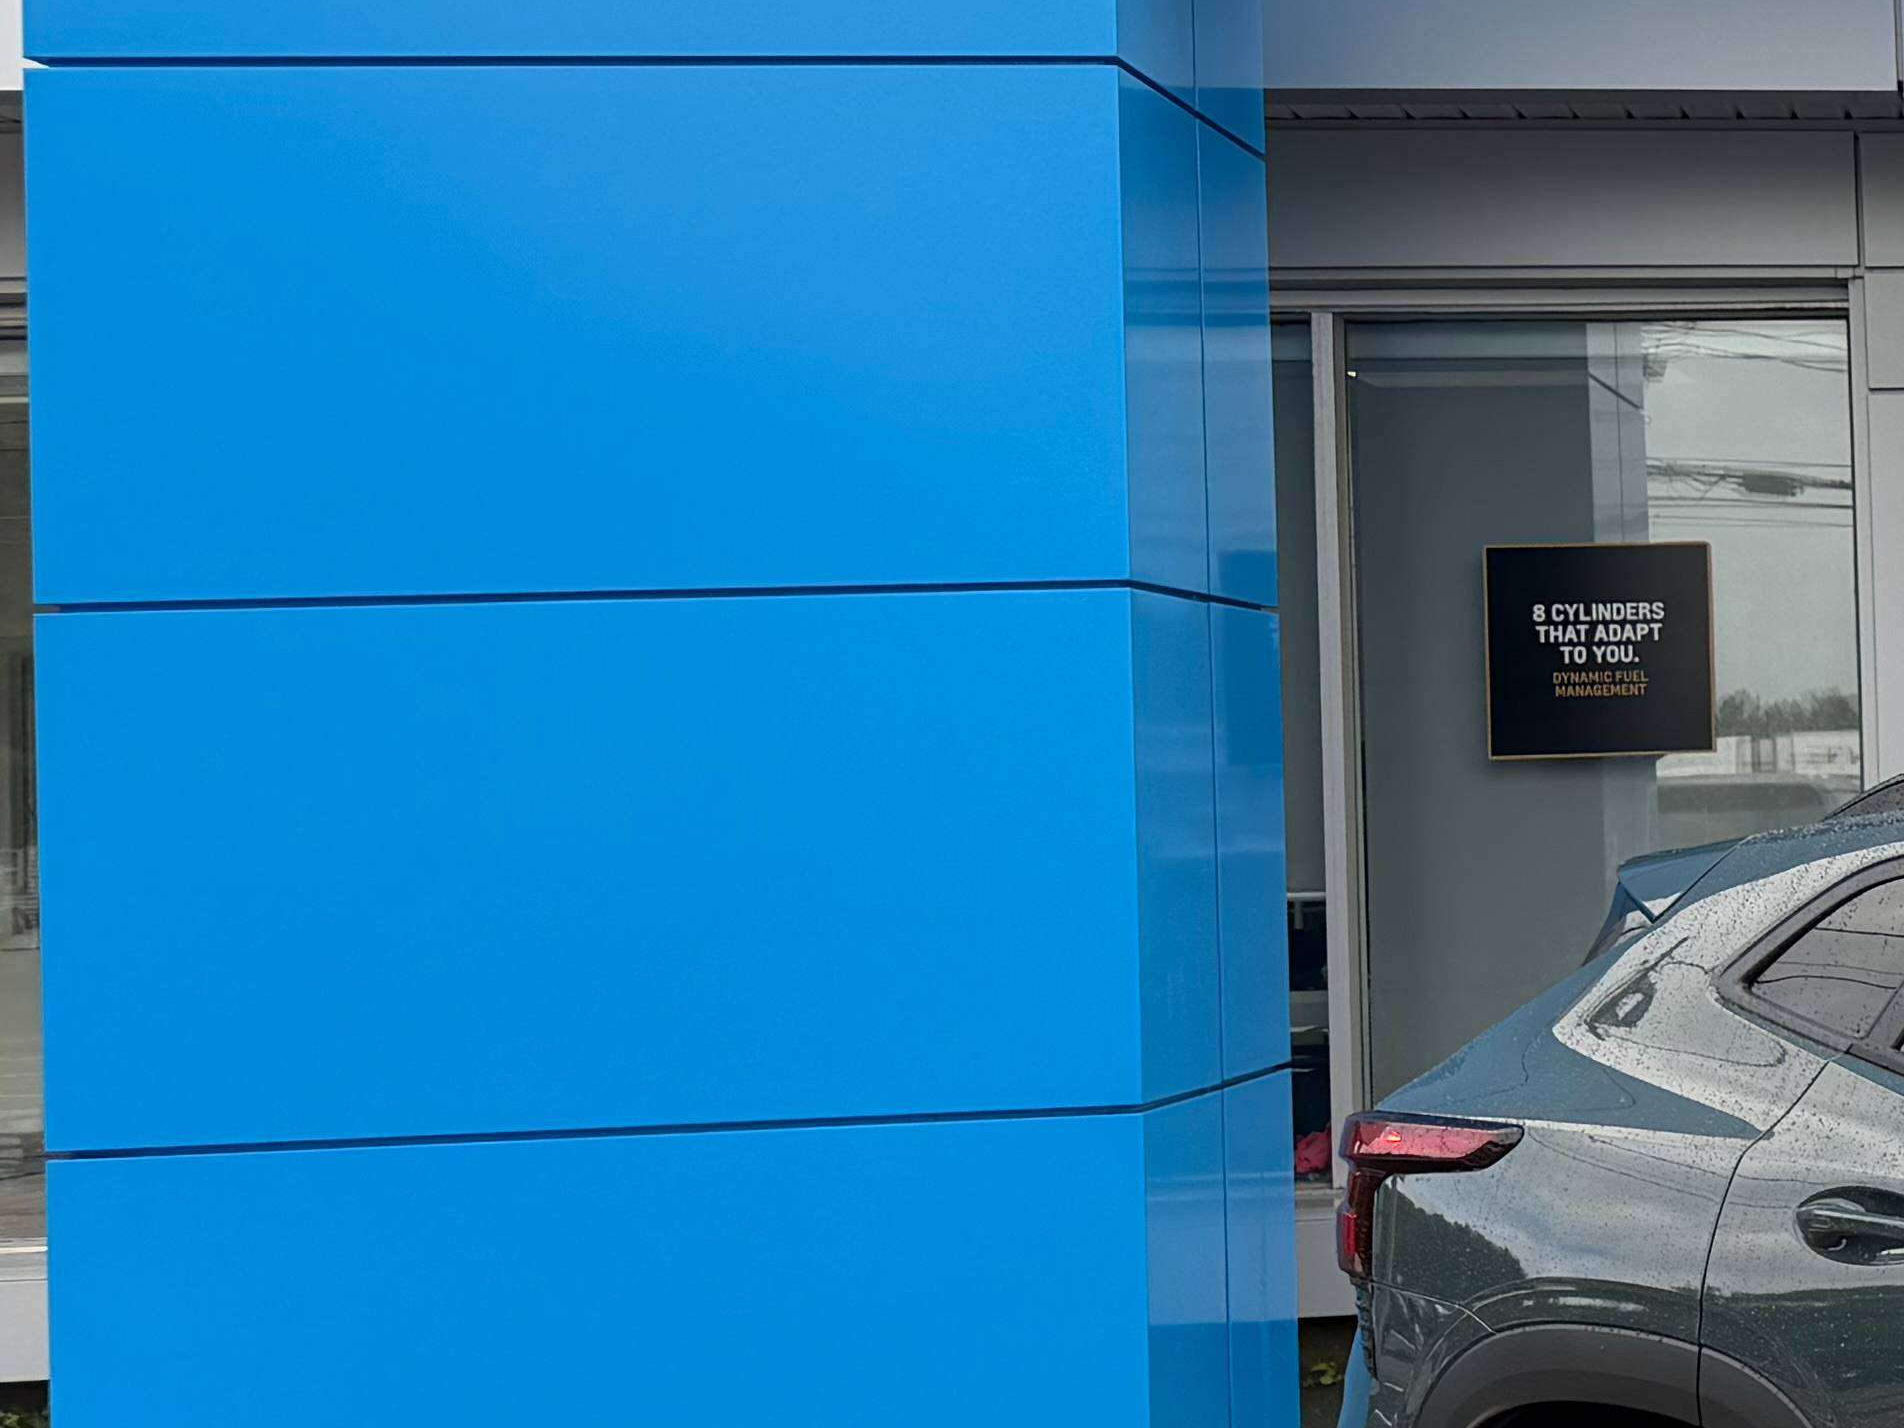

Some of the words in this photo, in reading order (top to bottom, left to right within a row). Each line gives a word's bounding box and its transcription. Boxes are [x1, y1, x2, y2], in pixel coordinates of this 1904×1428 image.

[1532, 604, 1545, 622] 8
[1551, 602, 1665, 622] CYLINDERS
[1535, 625, 1588, 643] THAT
[1594, 623, 1663, 642] ADAPT
[1559, 646, 1587, 664] TO
[1593, 645, 1640, 663] YOU.
[1552, 671, 1613, 684] DYNAMIC
[1615, 670, 1649, 682] FUEL
[1555, 683, 1648, 697] MANAGEMENT
